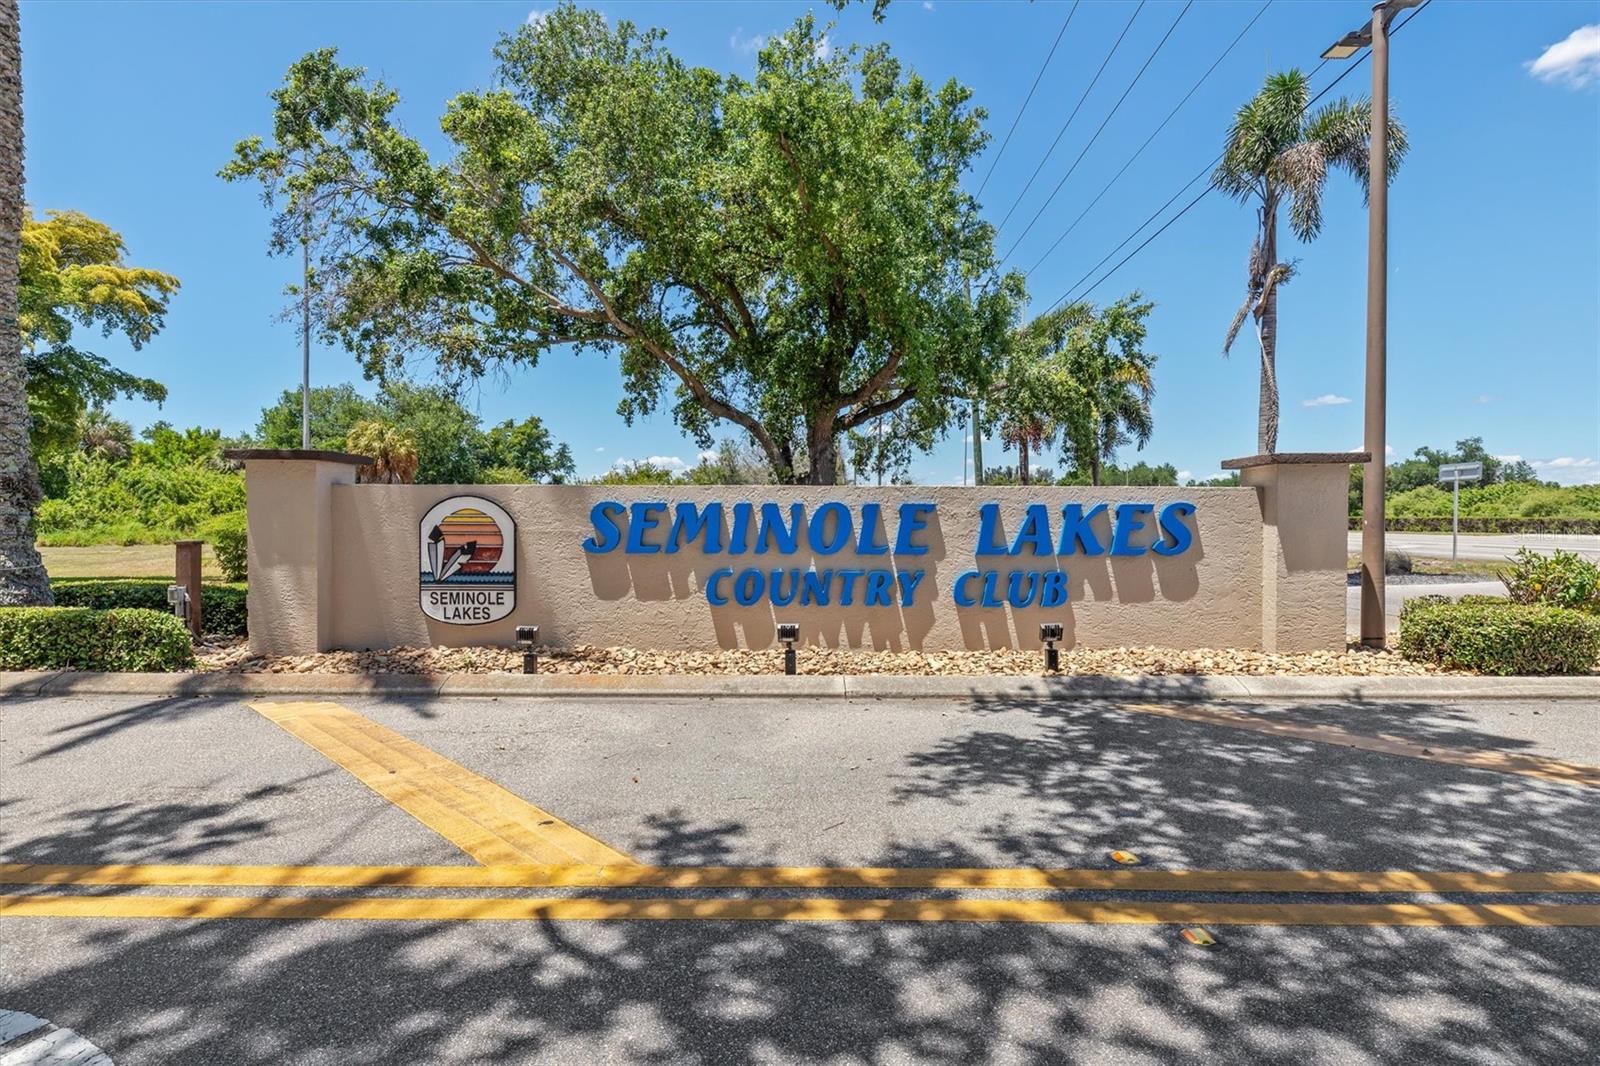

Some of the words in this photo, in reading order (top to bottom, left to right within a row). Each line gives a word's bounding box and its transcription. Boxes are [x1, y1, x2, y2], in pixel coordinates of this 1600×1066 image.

[581, 501, 937, 555] SEMINOLE
[975, 502, 1196, 556] LAKES
[430, 591, 505, 606] SEMINOLE
[705, 567, 924, 607] COUNTRY
[952, 570, 1068, 608] CLUB
[443, 606, 491, 620] LAKES
